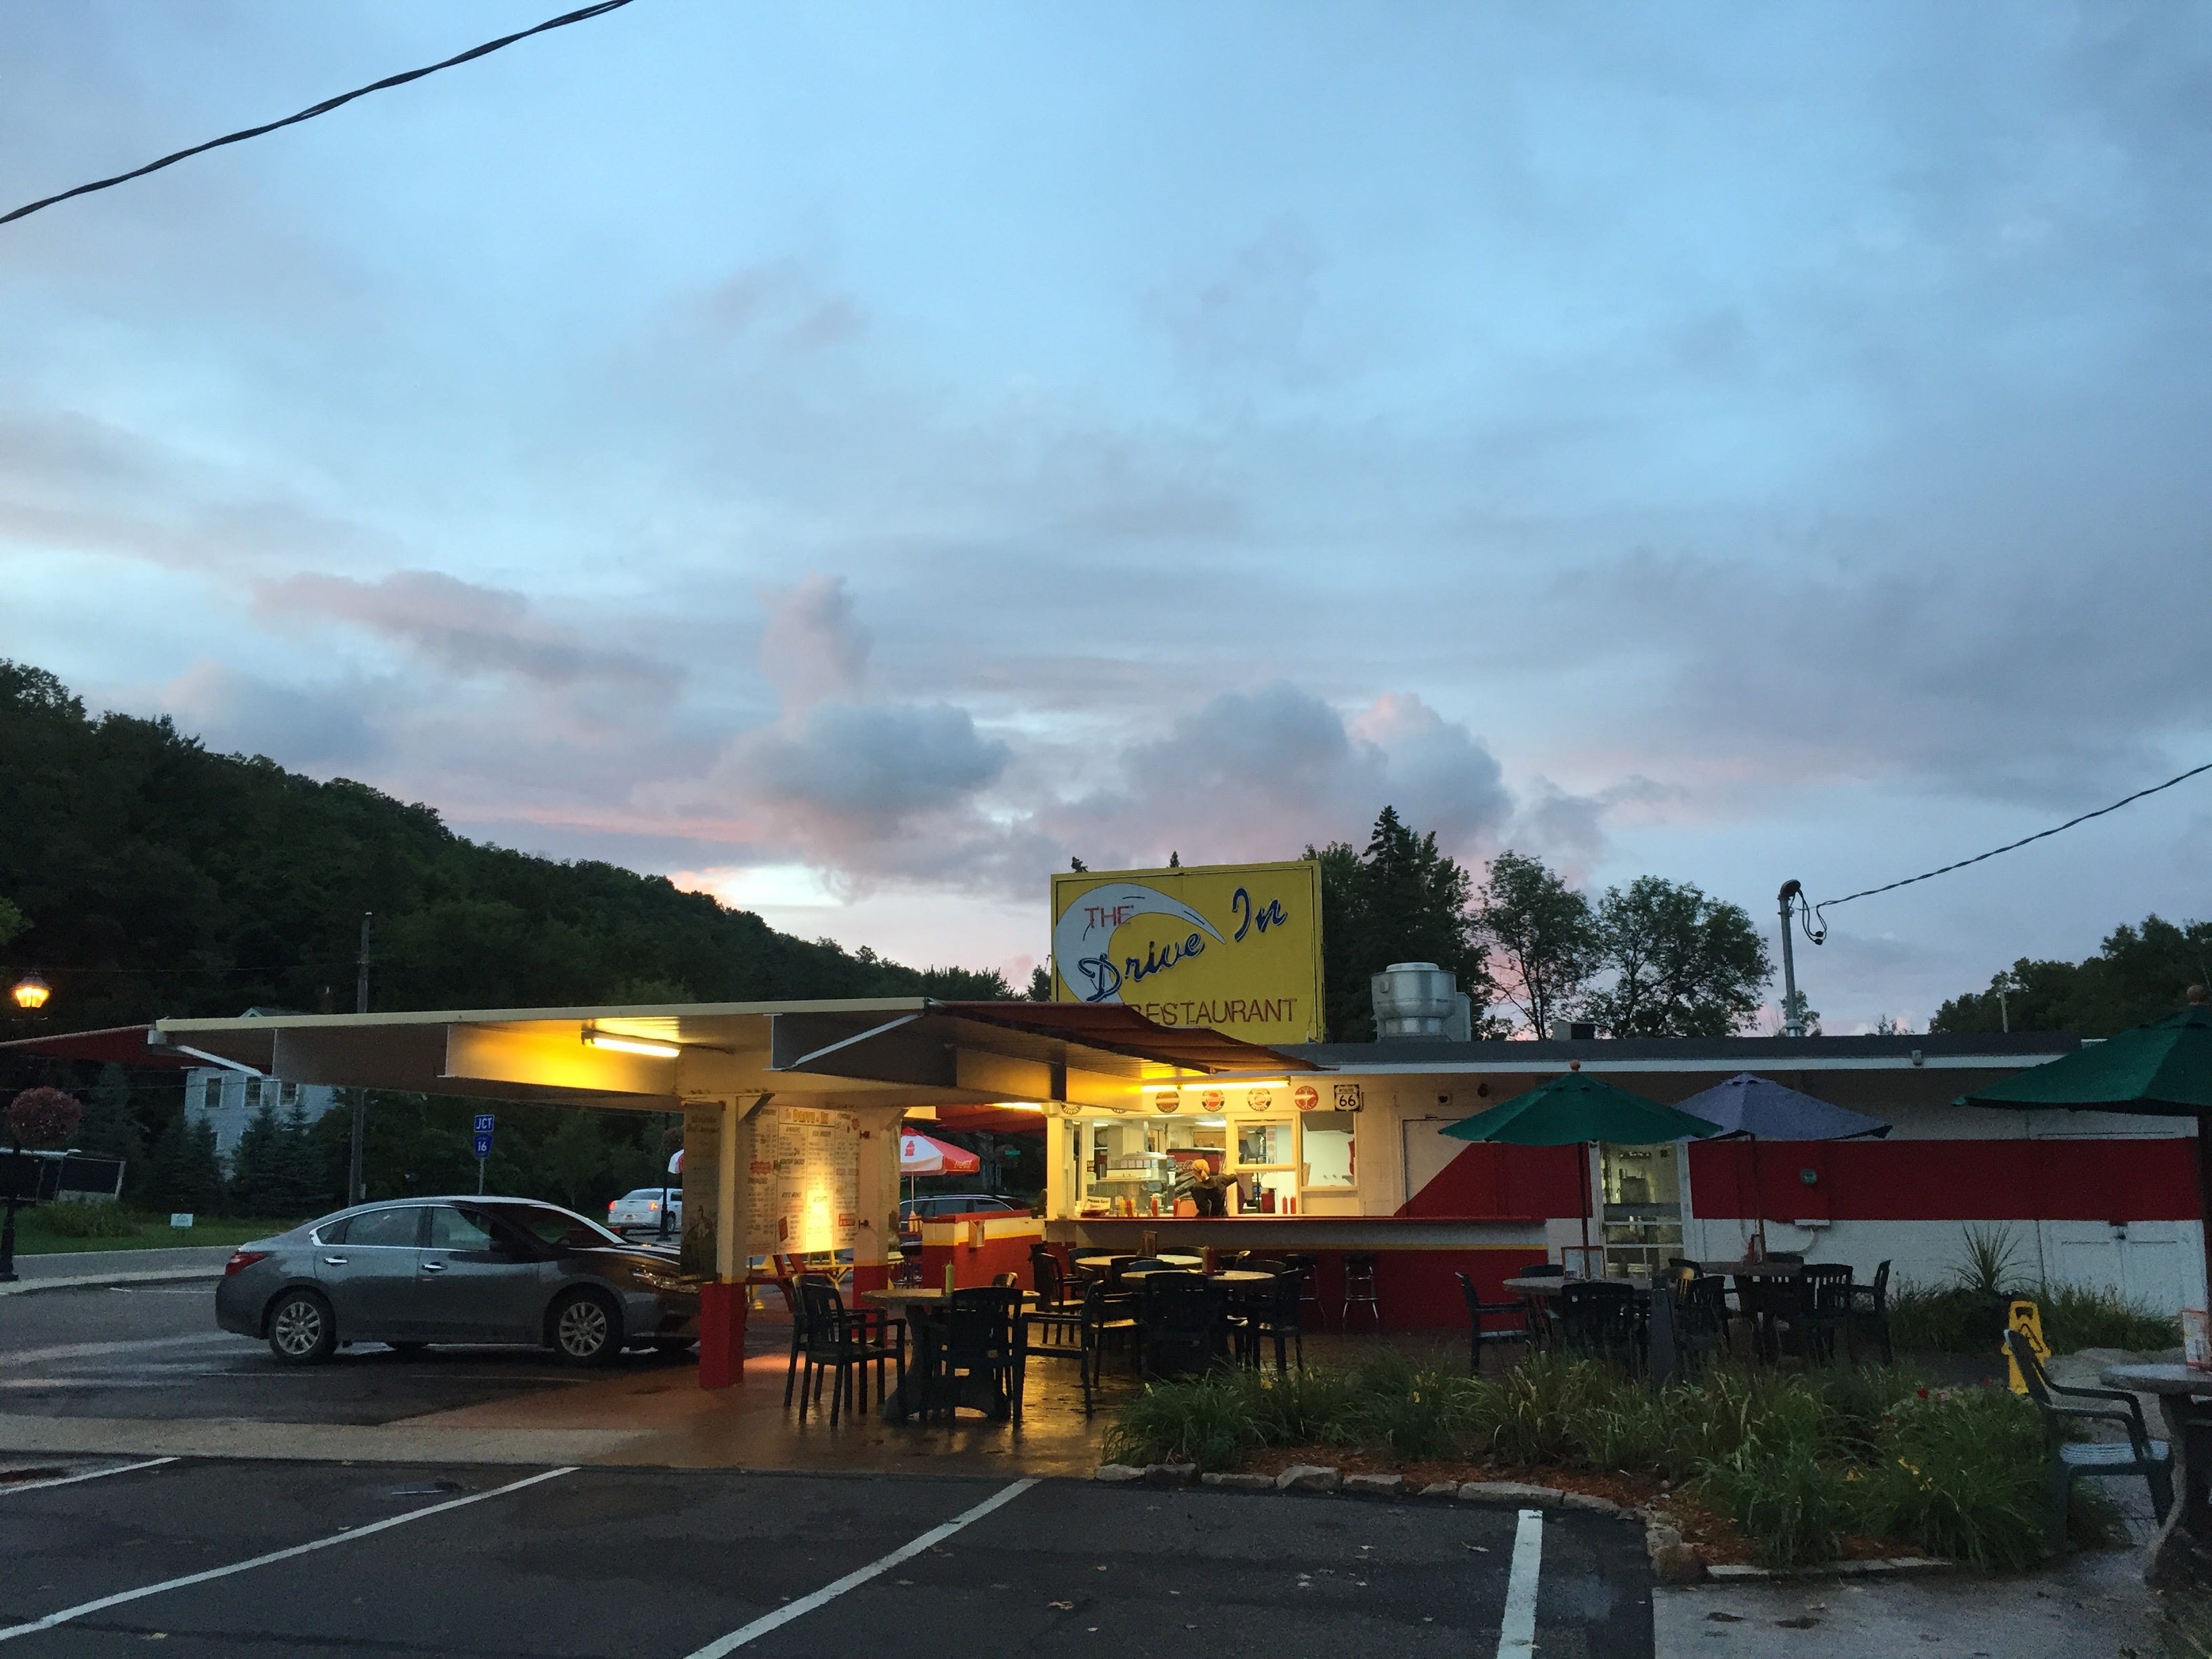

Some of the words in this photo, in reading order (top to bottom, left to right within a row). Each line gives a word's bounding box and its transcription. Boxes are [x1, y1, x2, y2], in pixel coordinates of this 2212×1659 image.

[1084, 905, 1131, 928] THE
[1078, 933, 1205, 1003] Drive
[1231, 886, 1288, 943] In
[1128, 998, 1297, 1025] ESTAURANT
[1339, 1094, 1356, 1107] 66
[476, 1118, 492, 1130] JCT
[478, 1141, 487, 1151] 16
